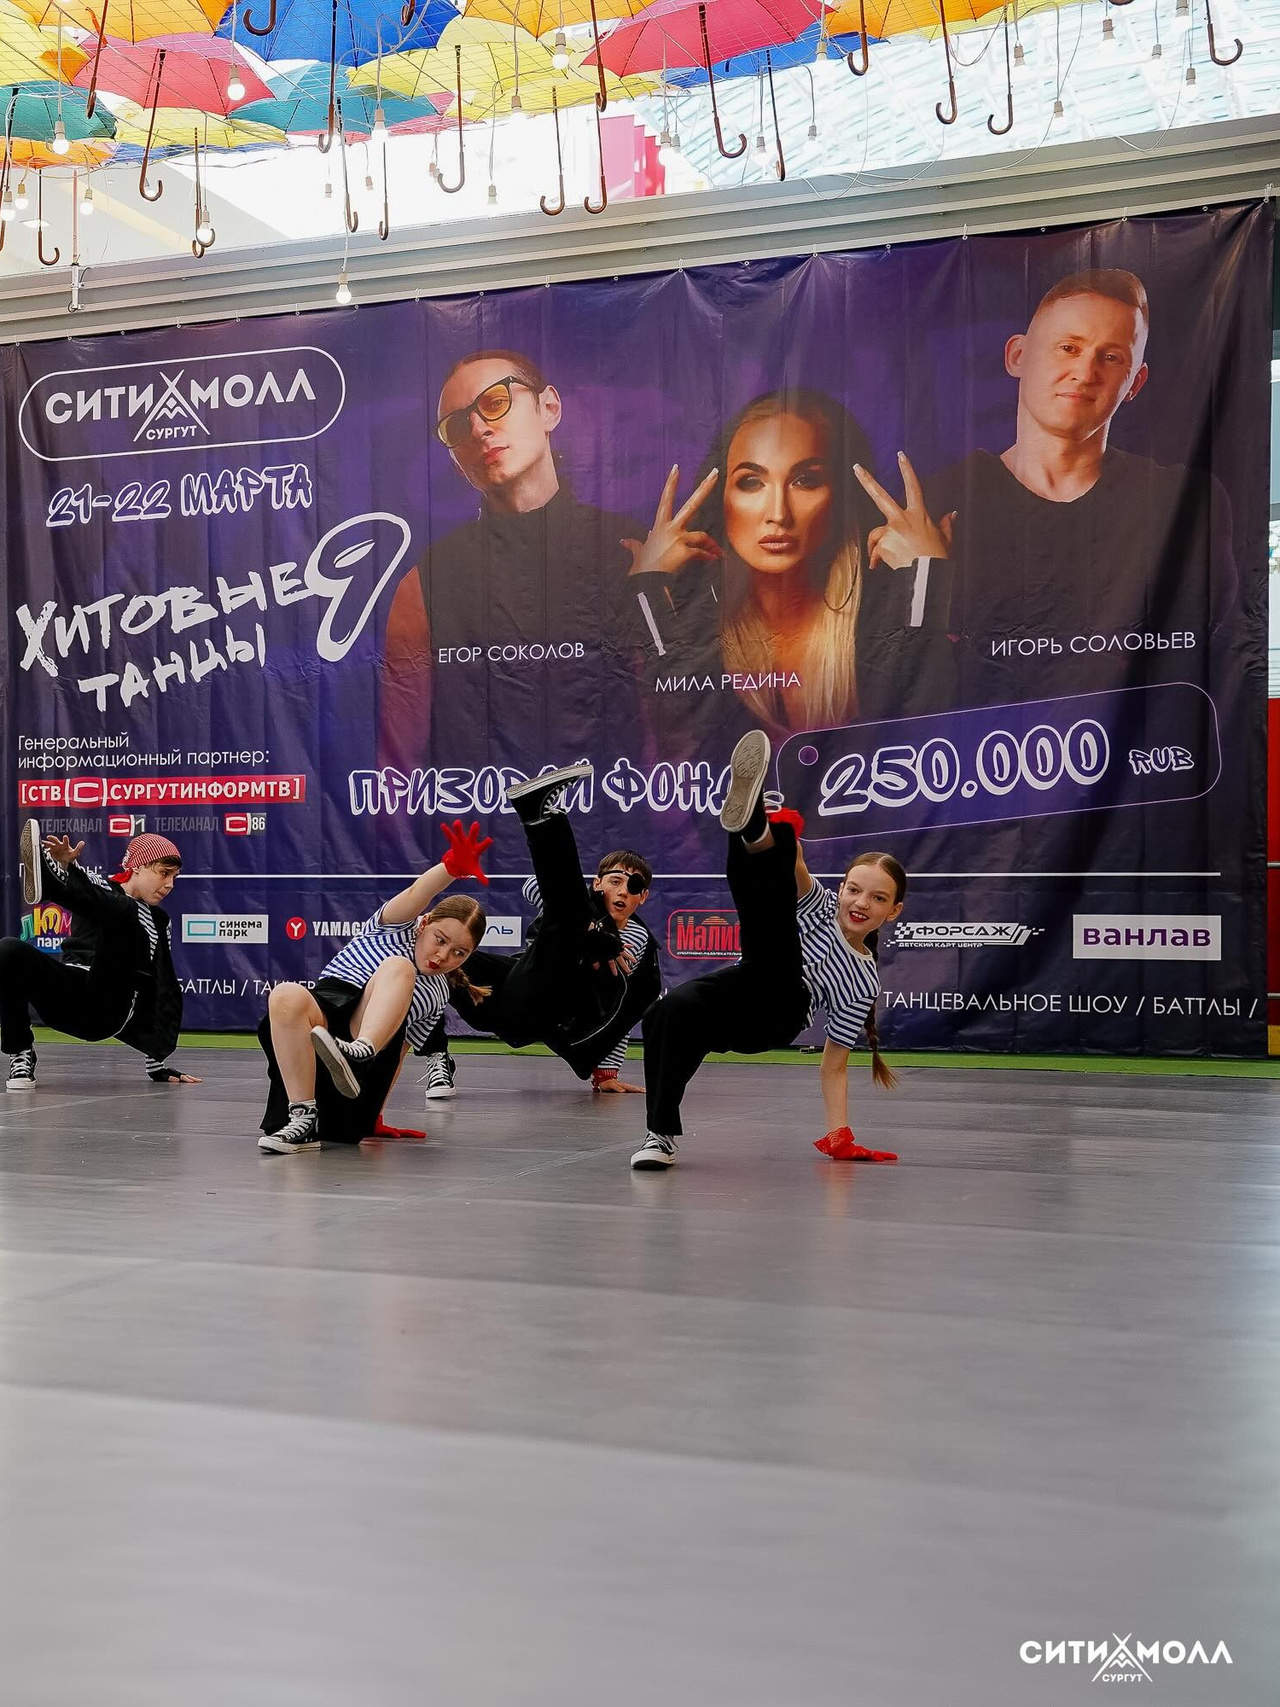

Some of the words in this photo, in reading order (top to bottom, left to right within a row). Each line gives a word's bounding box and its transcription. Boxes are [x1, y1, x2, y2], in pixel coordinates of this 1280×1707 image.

[45, 384, 154, 424] СИТИ
[190, 368, 317, 411] МОЛЛ
[145, 424, 198, 441] СУРГУТ
[45, 480, 171, 528] 21-22
[180, 463, 313, 517] МАРТА
[15, 562, 307, 678] ХИТОВЫЕ
[438, 647, 482, 664] ЕГОР
[487, 642, 585, 662] СОКОЛОВ
[991, 637, 1063, 657] ИГОРЬ
[1068, 631, 1197, 653] СОЛОВЬЕВ
[78, 623, 268, 713] ТАНЦЫ
[655, 674, 715, 692] МИЛА
[721, 671, 801, 691] РЕДИНА
[18, 731, 130, 754] Генеральный
[18, 748, 182, 772] информационный
[187, 749, 270, 769] партнер:
[818, 718, 1111, 817] 250.000
[1128, 745, 1195, 776] RUB
[348, 757, 595, 815] ПРИЗОЙ
[40, 817, 102, 833] ТЕЛЕКАНАЛ
[154, 816, 219, 832] ТЕЛЕКАНАЛ
[219, 920, 262, 929] синема
[219, 929, 248, 939] парк
[312, 920, 366, 937] YAMAG
[915, 925, 1012, 936] ФОРСАЖ
[1083, 928, 1211, 947] ванлав
[883, 991, 1062, 1012] ТАНЦЕВАЛЬНОЕ
[1069, 995, 1128, 1014] ШОУ
[1153, 997, 1241, 1016] БАТТЛЫ
